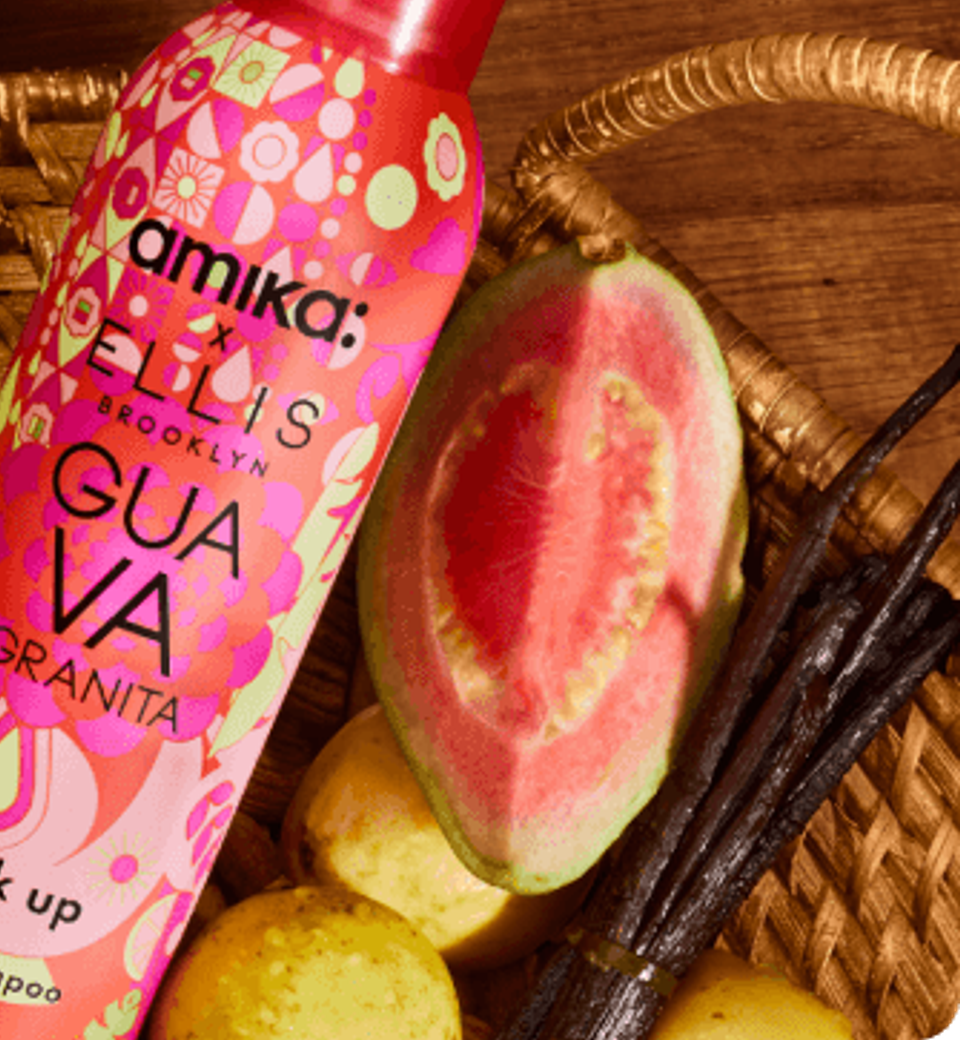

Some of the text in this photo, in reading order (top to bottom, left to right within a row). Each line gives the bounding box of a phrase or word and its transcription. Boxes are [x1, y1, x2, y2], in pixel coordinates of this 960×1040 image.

[129, 218, 369, 350] amika:
[86, 317, 320, 449] ELLIS
[97, 395, 269, 477] BROOKLYN
[52, 441, 239, 579] GUA
[54, 525, 170, 677] VA
[26, 888, 82, 930] up
